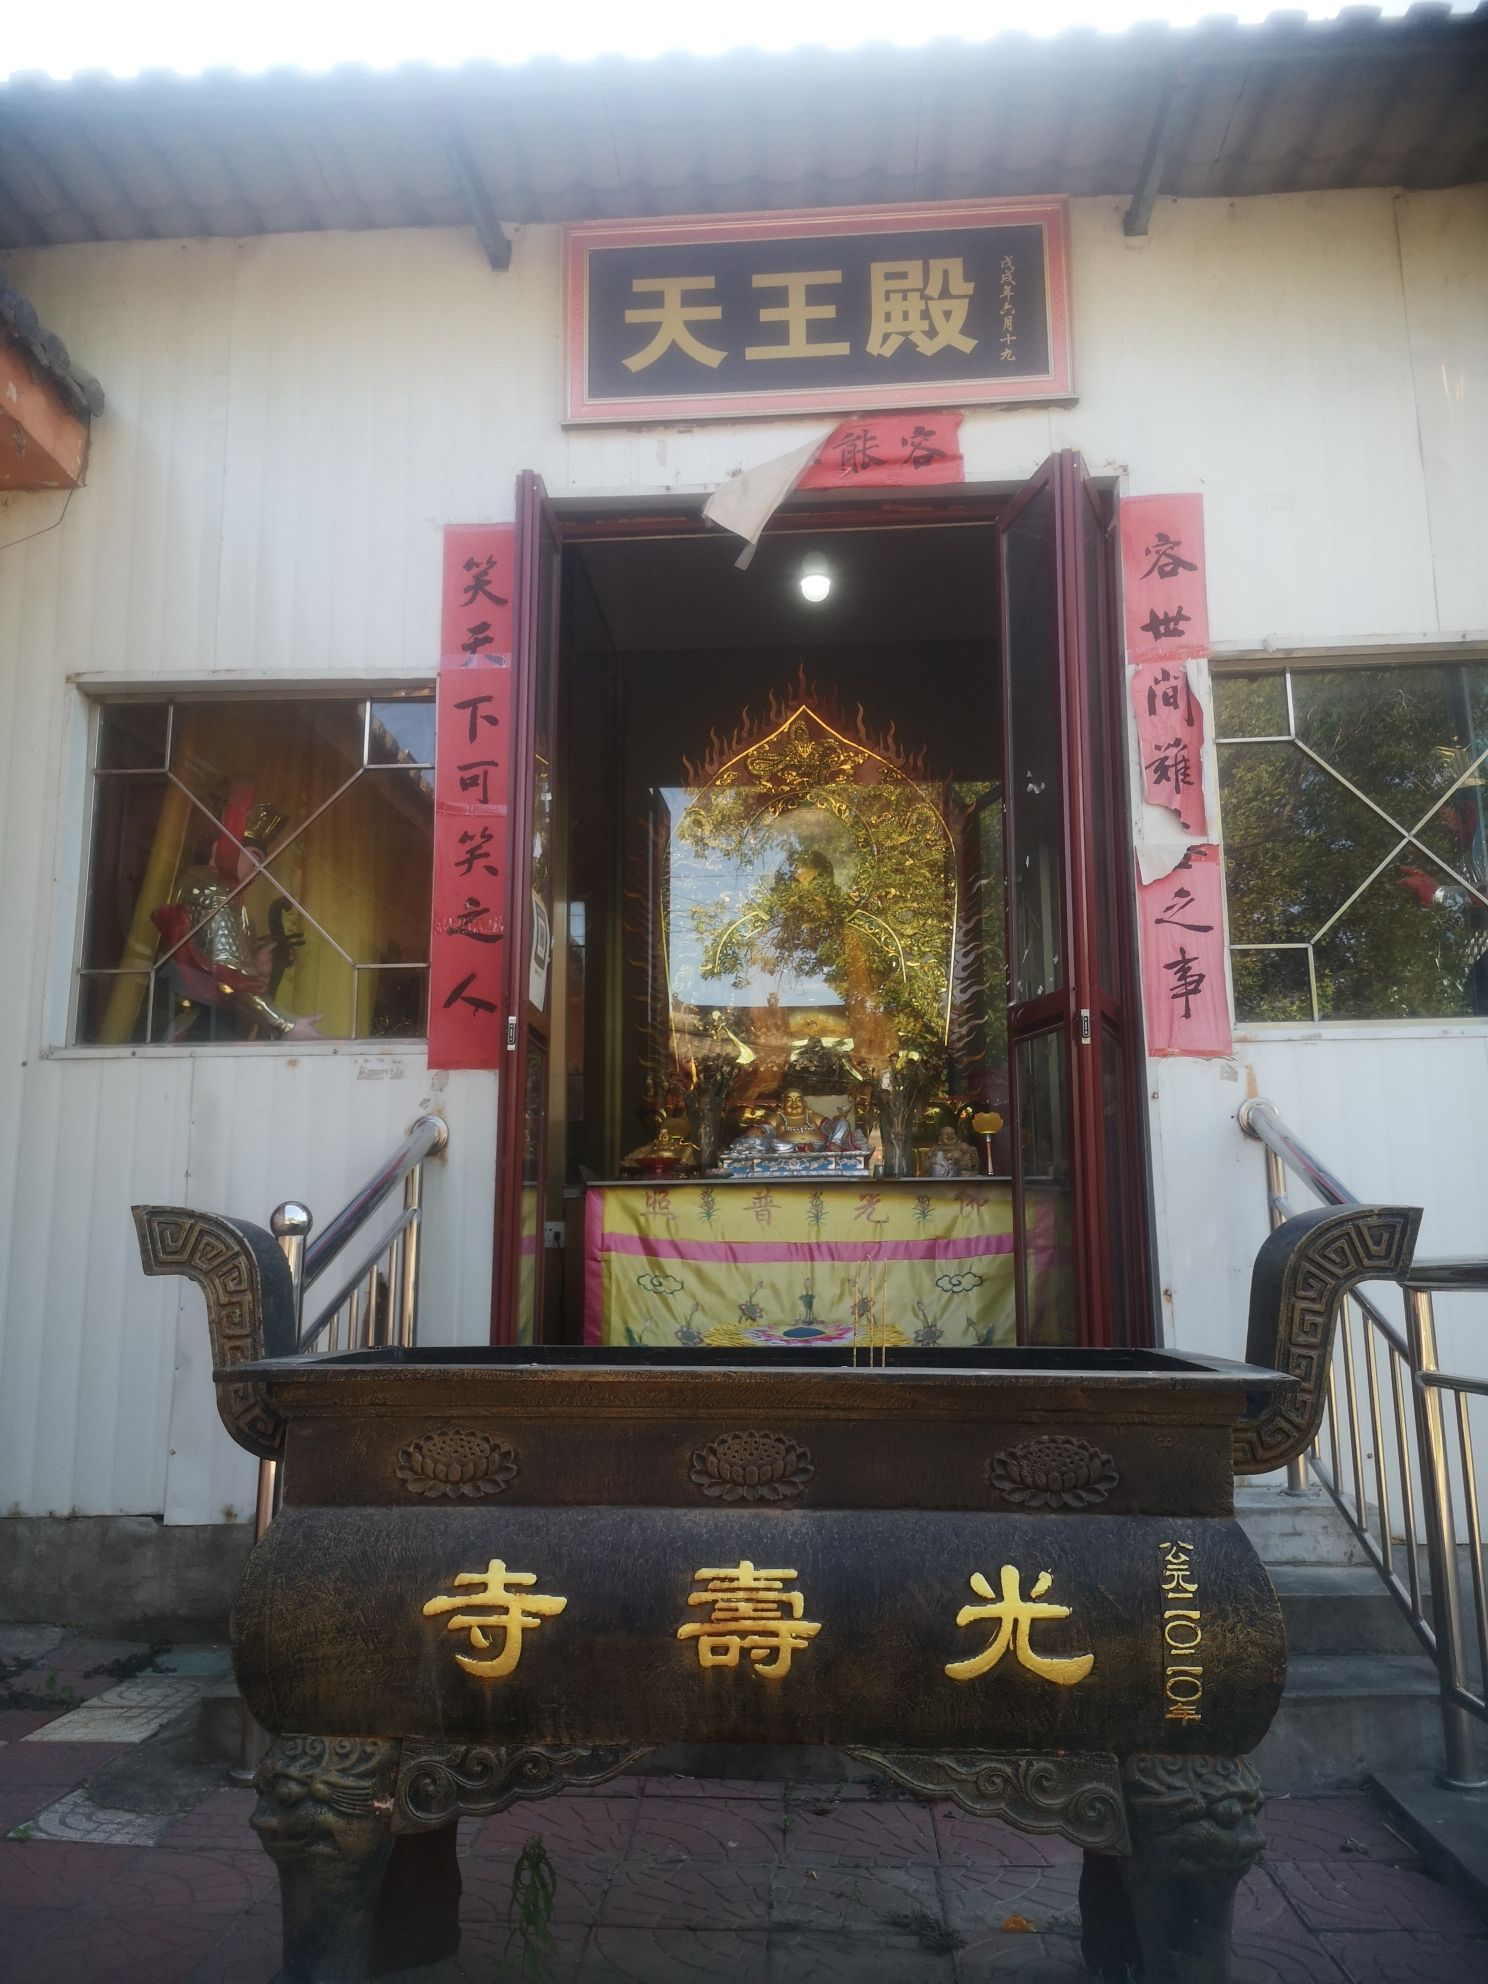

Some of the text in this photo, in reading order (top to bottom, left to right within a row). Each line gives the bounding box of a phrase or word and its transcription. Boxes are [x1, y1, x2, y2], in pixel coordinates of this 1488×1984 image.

[622, 257, 978, 373] 天王殿
[442, 556, 509, 1017] 笑天下可笑之人
